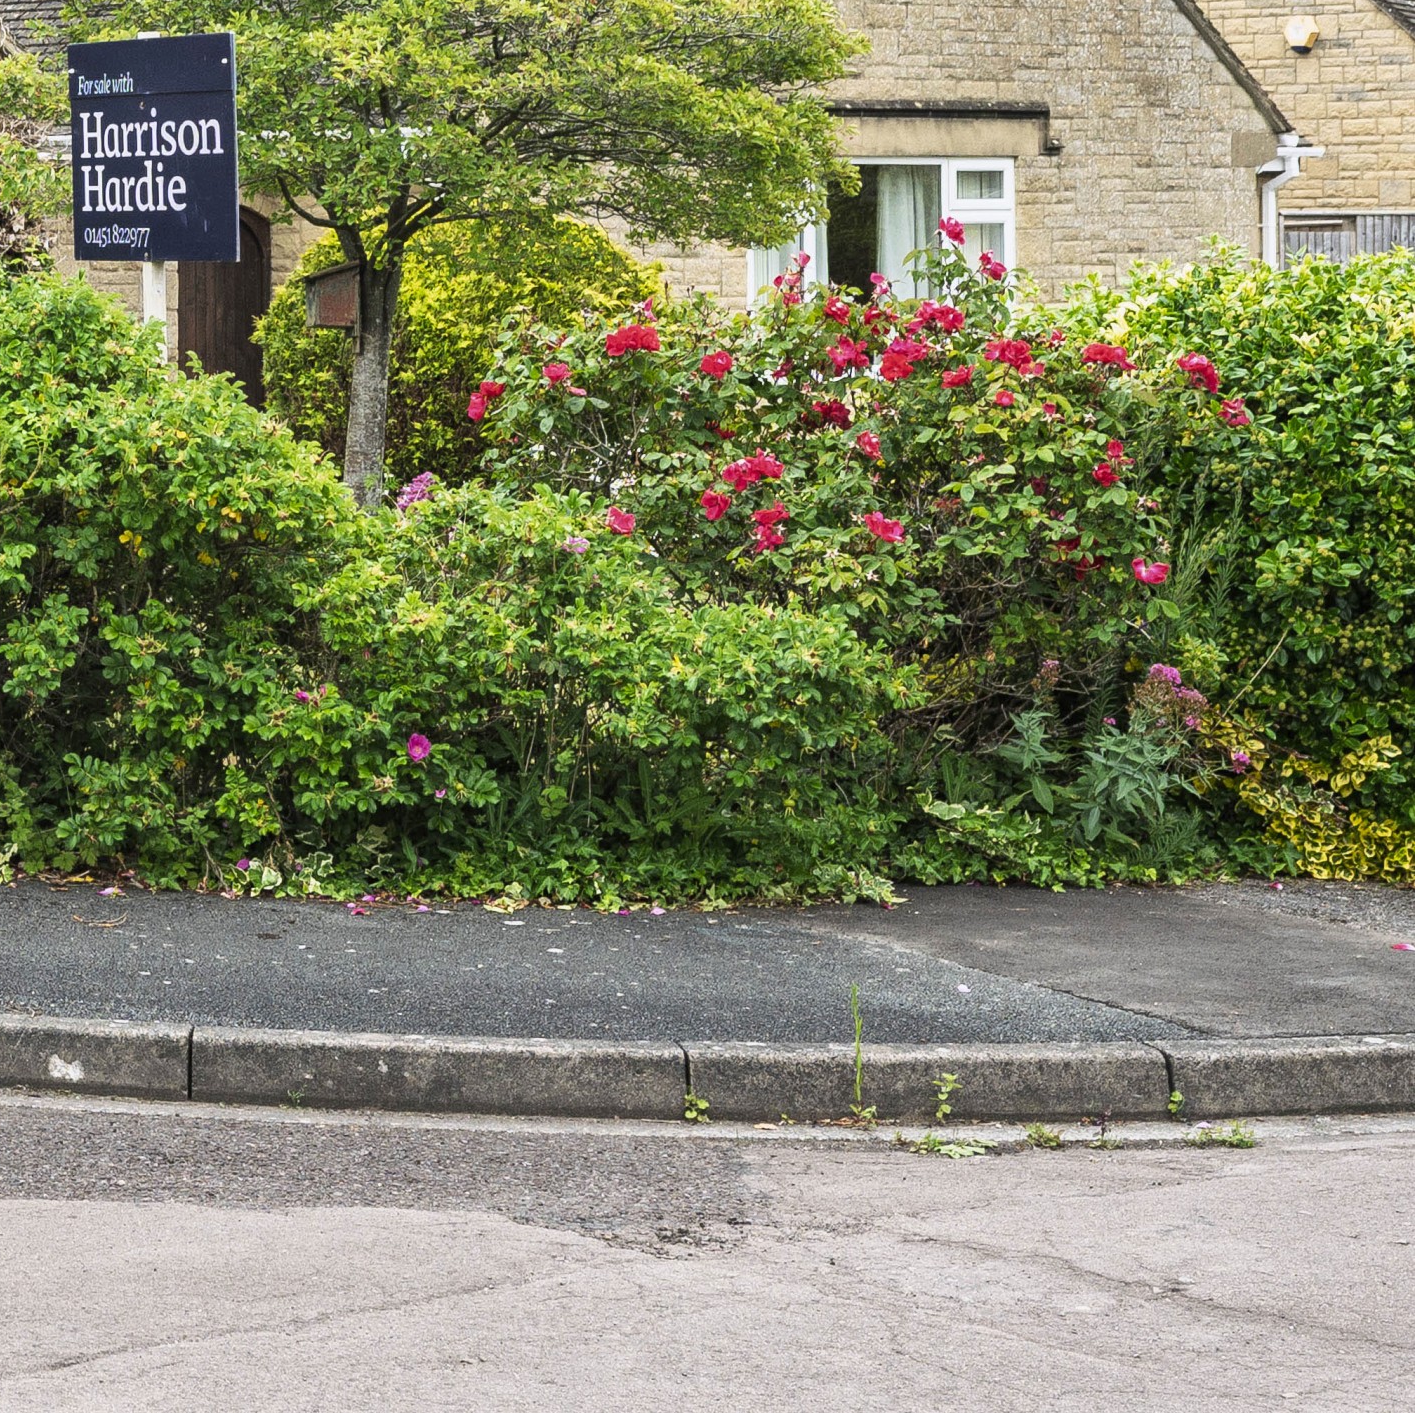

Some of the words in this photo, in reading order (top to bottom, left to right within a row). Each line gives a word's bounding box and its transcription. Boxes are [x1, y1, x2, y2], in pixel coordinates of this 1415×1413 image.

[78, 75, 93, 95] For
[94, 73, 111, 94] sale
[112, 71, 134, 93] with
[79, 107, 224, 158] Harrison
[81, 160, 187, 212] Hardie
